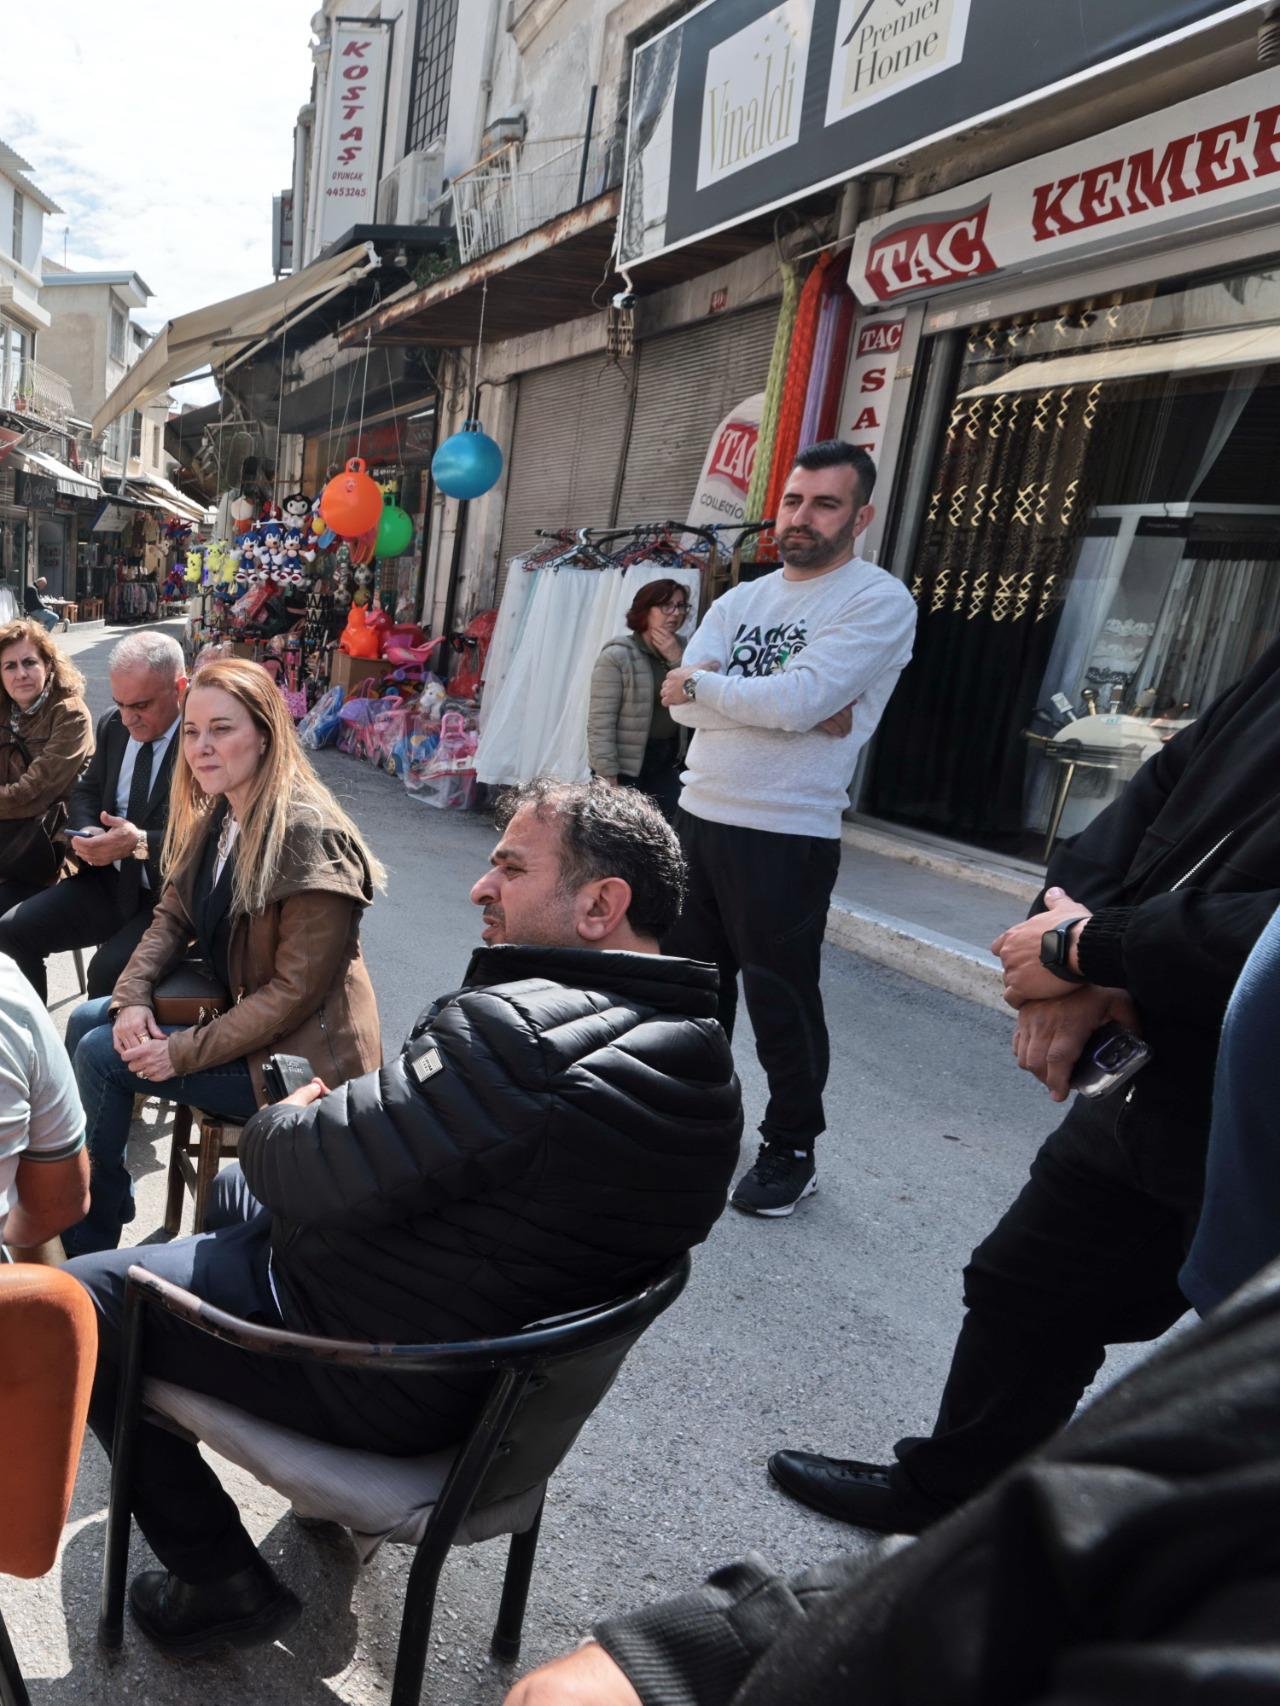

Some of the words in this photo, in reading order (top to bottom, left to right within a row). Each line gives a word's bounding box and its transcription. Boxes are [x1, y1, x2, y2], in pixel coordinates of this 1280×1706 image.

[858, 0, 940, 55] Premier
[851, 31, 938, 94] Home
[336, 40, 372, 166] KOSTAŞ
[708, 41, 797, 175] Vinaldi
[326, 187, 367, 198] 4453245
[332, 171, 364, 181] OYUNCAK
[871, 217, 981, 293] TAÇ
[860, 323, 902, 353] TAÇ
[851, 367, 886, 452] SA
